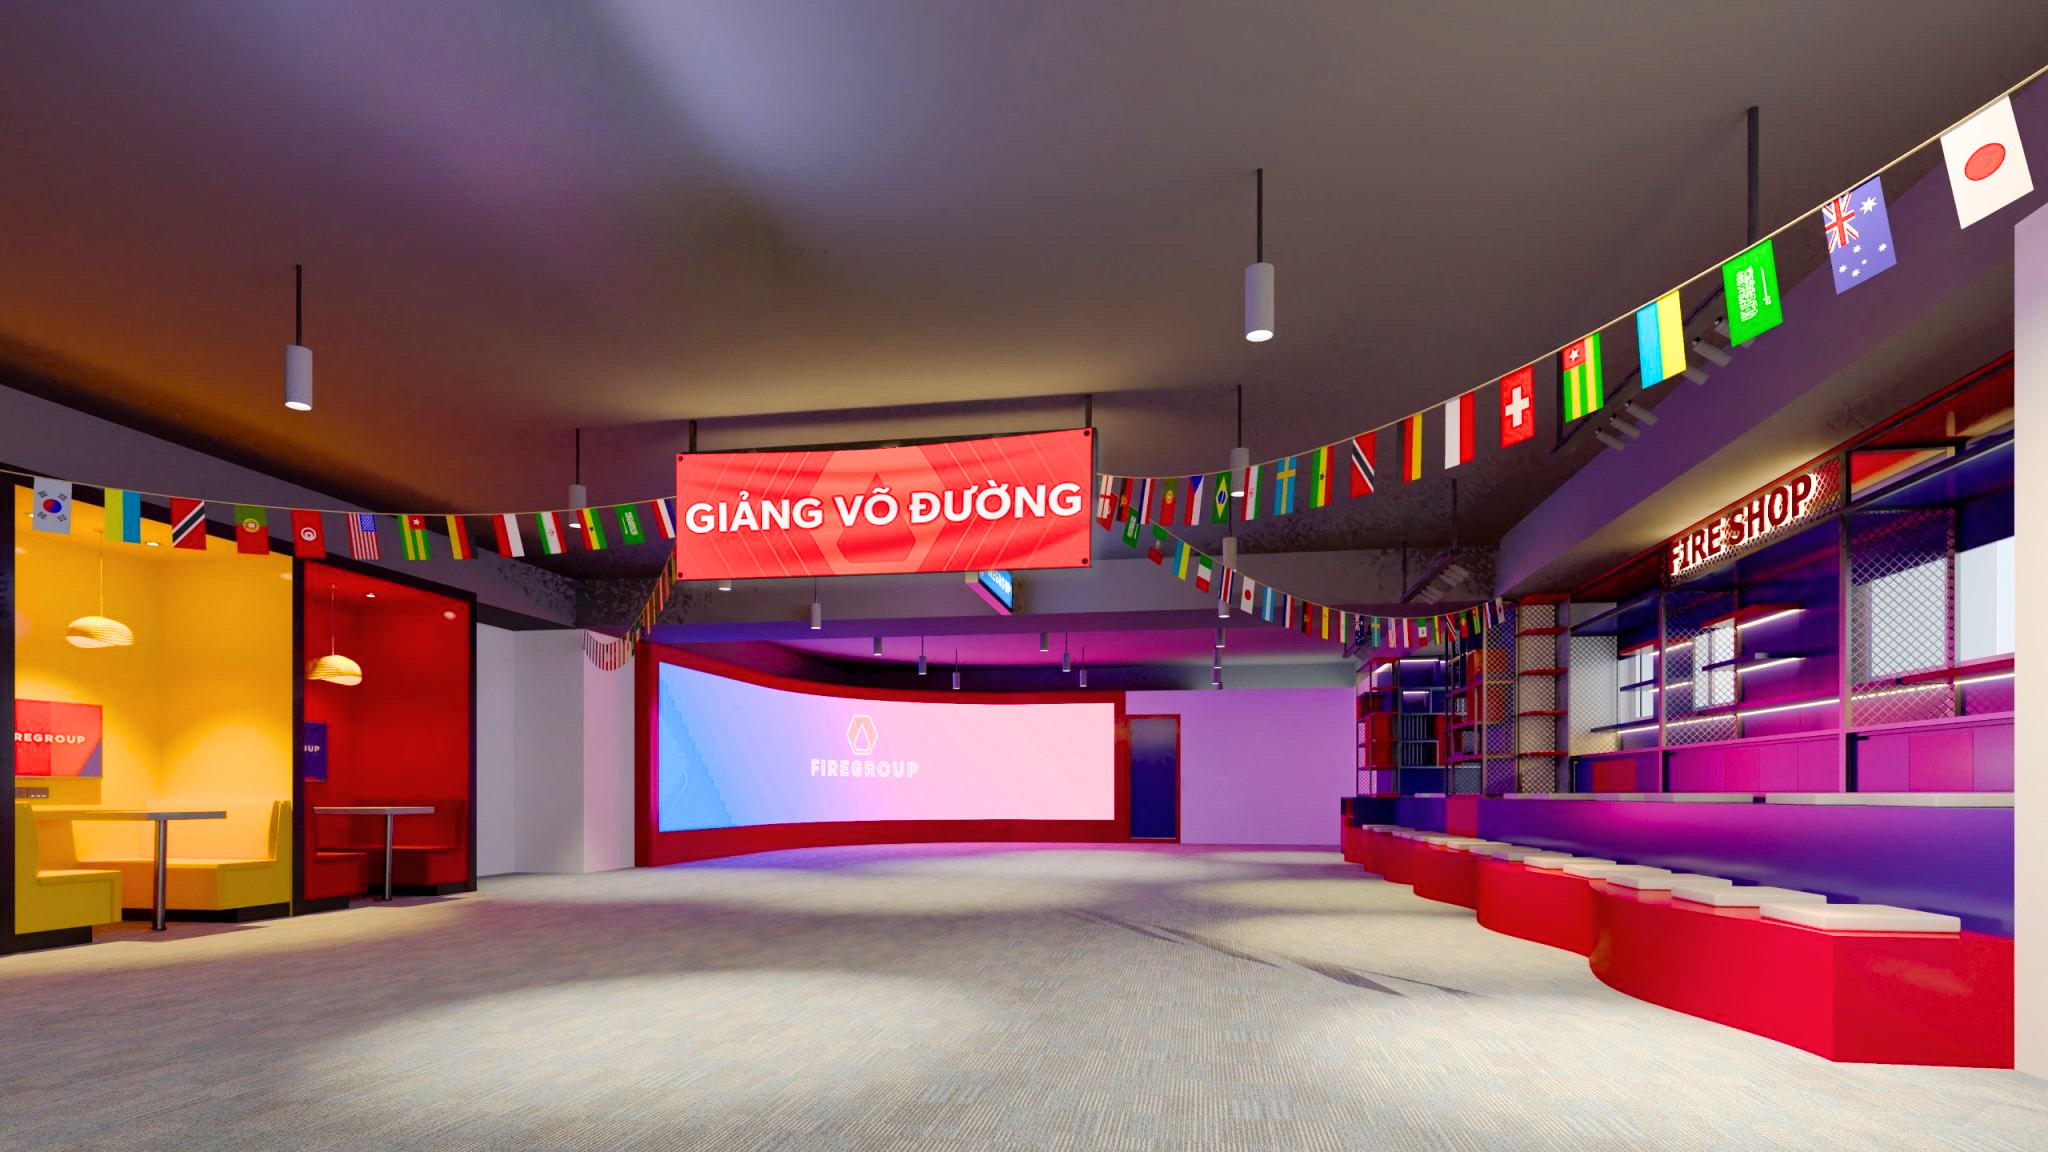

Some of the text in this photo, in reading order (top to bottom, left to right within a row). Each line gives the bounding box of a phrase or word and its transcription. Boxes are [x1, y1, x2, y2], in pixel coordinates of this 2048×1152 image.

[685, 491, 824, 533] GIẢNG
[834, 487, 898, 527] VÕ
[909, 480, 1082, 524] ĐƯỜNG
[1669, 473, 1815, 576] FIRE SHOP
[811, 758, 919, 778] FIREGROUP
